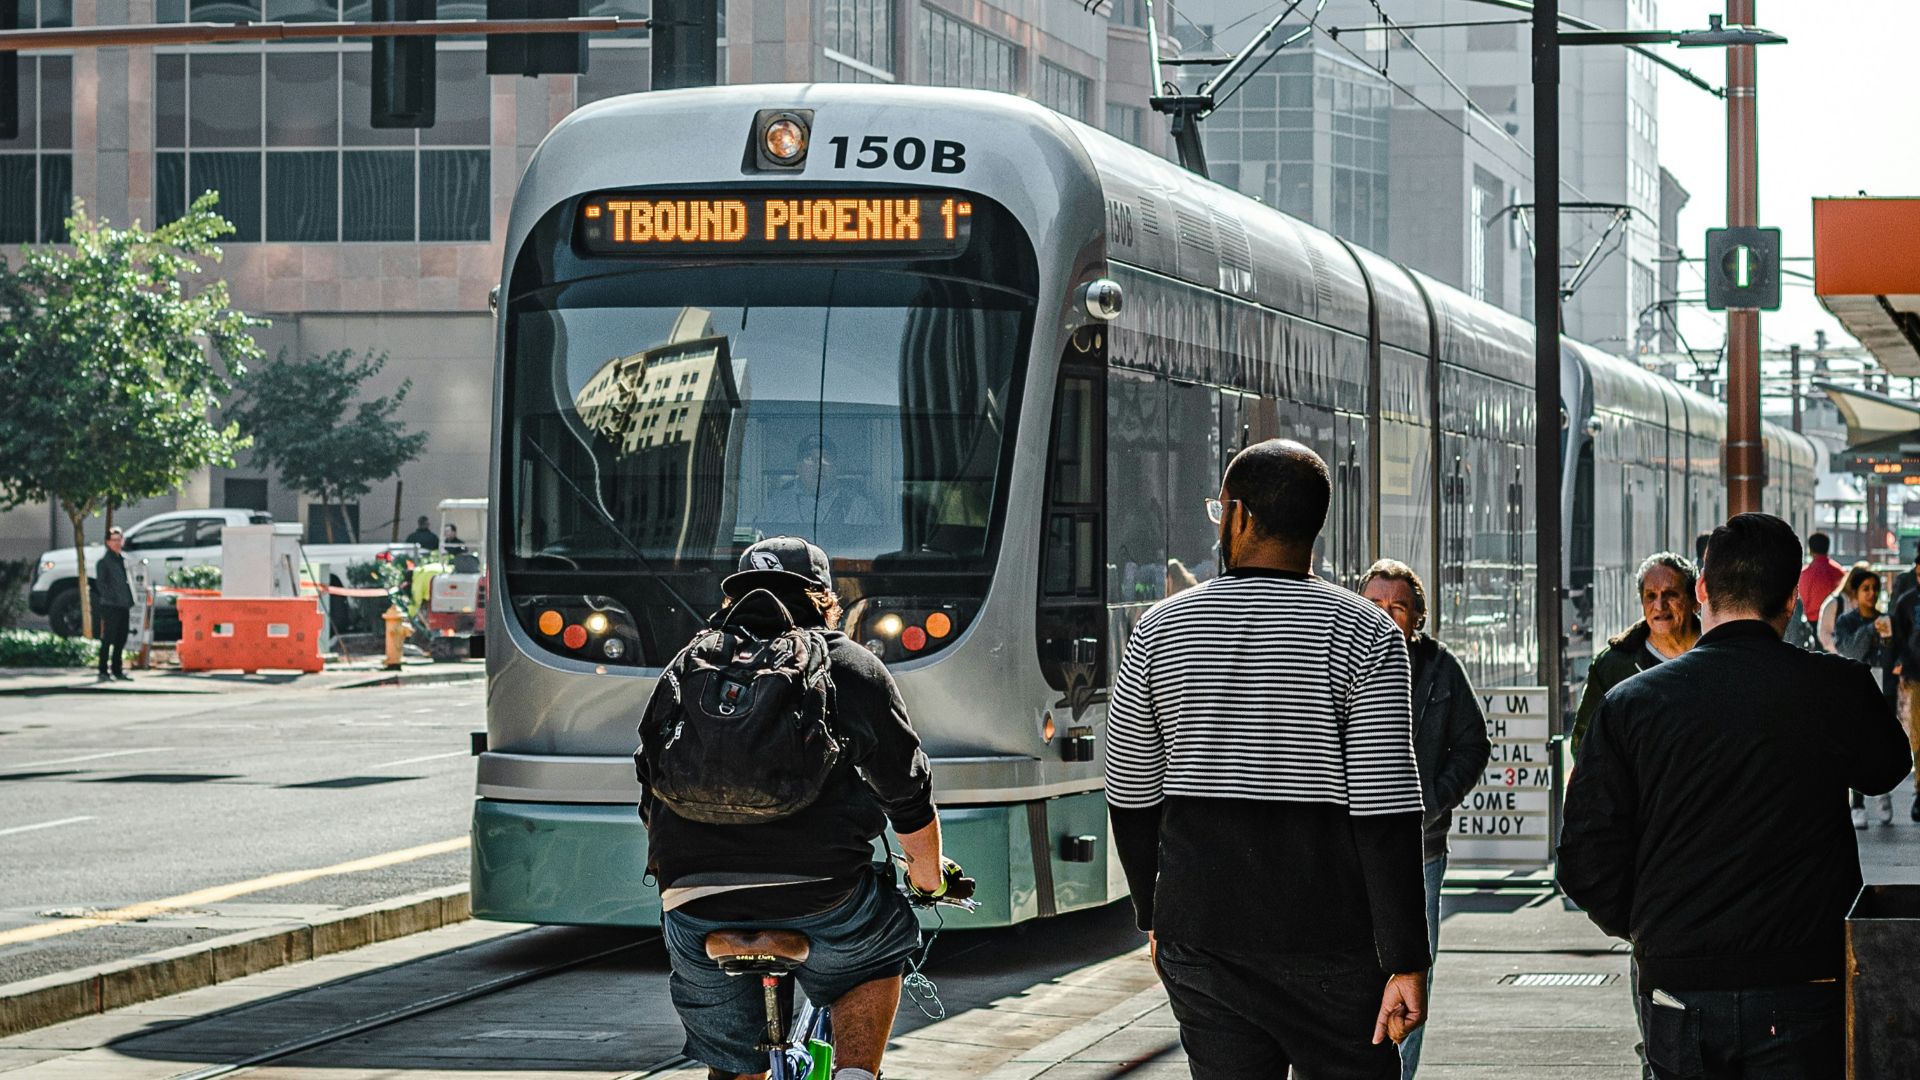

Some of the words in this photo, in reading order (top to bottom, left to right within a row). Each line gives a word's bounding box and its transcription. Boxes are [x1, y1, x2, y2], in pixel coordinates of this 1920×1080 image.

[828, 135, 967, 174] 150B
[607, 200, 748, 242] TBOUND
[765, 198, 920, 241] PHOENIX
[1108, 200, 1133, 248] 150B
[1459, 816, 1524, 835] ENJOY
